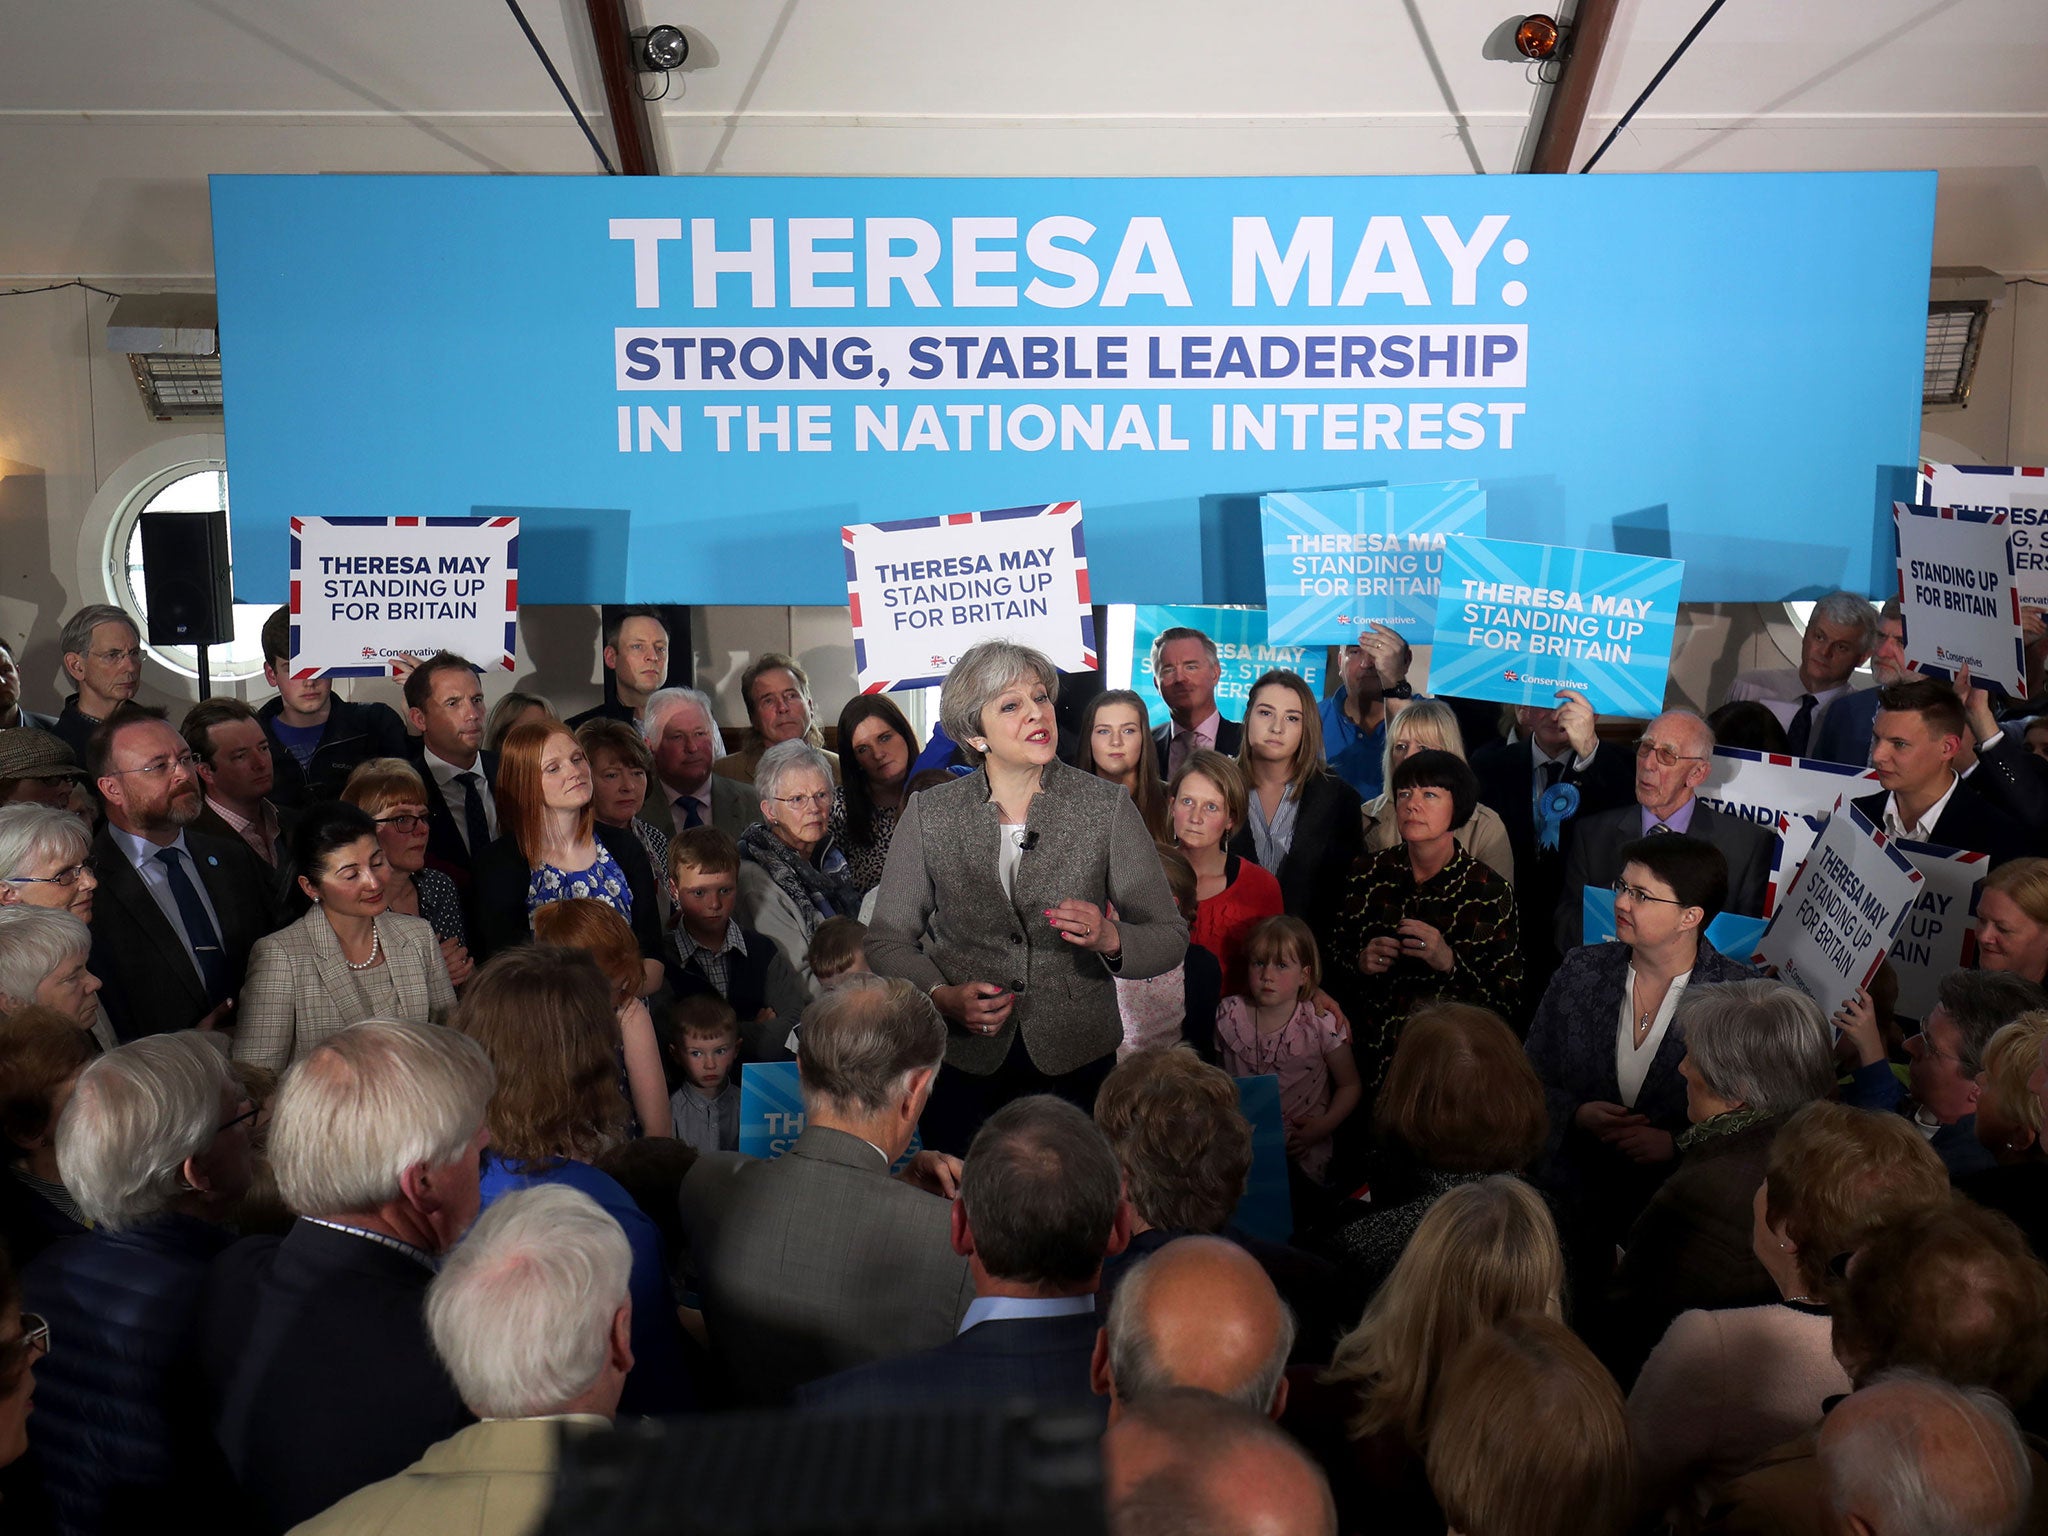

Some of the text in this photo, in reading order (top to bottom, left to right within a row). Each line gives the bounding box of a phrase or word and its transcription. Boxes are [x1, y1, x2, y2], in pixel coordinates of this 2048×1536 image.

[609, 215, 1530, 308] THERESA MAY:
[625, 335, 1519, 387] STRONG, STABLE LEADERSHIP
[618, 402, 1526, 452] IN THE NATIONAL INTEREST
[1287, 533, 1401, 553] THERESA
[319, 556, 491, 575] THERESA MAY
[875, 547, 1055, 583] THERESA MAY
[1292, 555, 1442, 575] STANDING U
[1911, 560, 1999, 592] STANDING UP
[324, 579, 485, 598] STANDING UP
[883, 572, 1052, 607] STANDING UP
[1300, 577, 1348, 597] FOR
[1461, 579, 1654, 620] THERESA MAY
[1916, 585, 1942, 608] FOR
[1944, 590, 1998, 618] BRITAIN
[332, 602, 477, 621] FOR BRITAIN
[894, 597, 1048, 631] FOR BRITAIN
[1353, 615, 1416, 625] Conservatives
[1463, 604, 1644, 641] STANDING UP
[379, 646, 447, 657] Conservative
[1258, 646, 1306, 663] MAY
[1468, 627, 1632, 664] FOR BRITAIN
[1520, 673, 1589, 690] Conservatives
[1819, 845, 1890, 930] THERESA MAY
[1807, 872, 1872, 952] STANDING UP
[1911, 916, 1943, 940] UP
[1796, 898, 1856, 978] FOR BRITAIN
